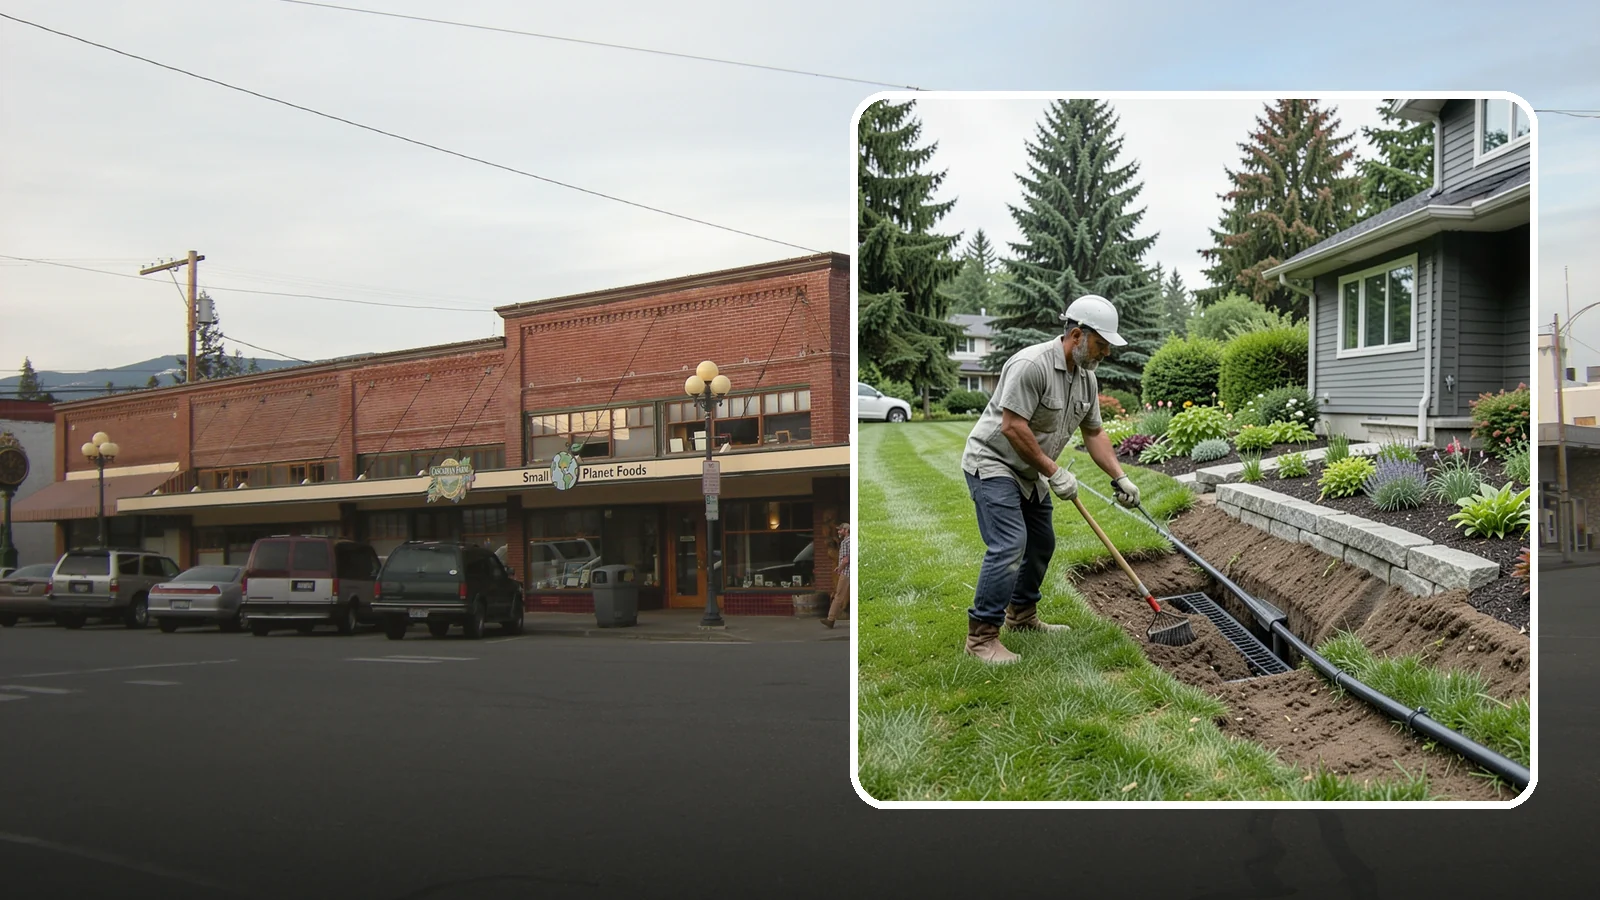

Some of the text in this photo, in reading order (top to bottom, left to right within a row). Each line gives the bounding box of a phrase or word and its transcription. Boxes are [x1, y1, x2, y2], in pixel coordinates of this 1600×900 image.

[523, 464, 647, 482] Small Planet Foods
